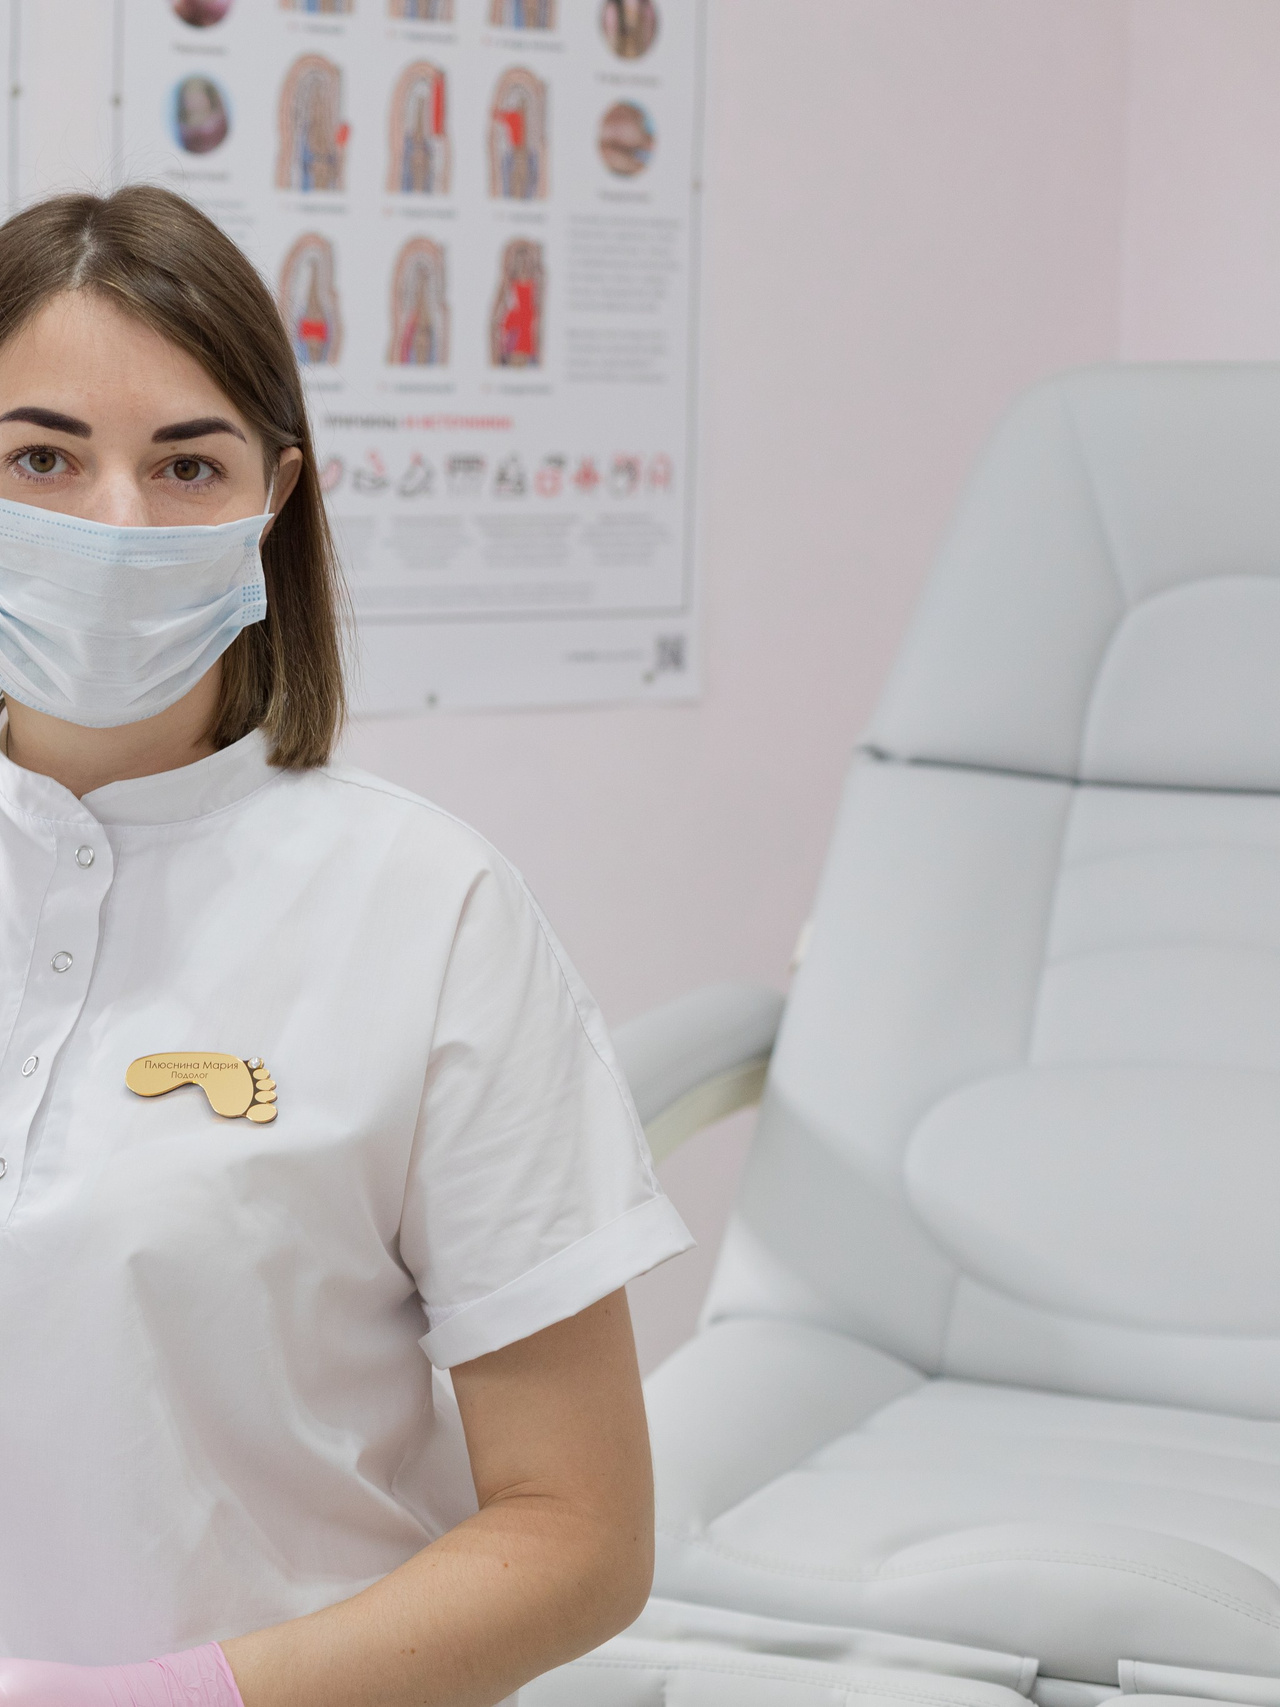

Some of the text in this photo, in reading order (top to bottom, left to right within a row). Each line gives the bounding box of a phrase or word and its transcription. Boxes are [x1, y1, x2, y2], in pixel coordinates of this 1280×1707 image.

[144, 1060, 239, 1071] Плюснина Мария
[171, 1070, 209, 1079] Подолог
